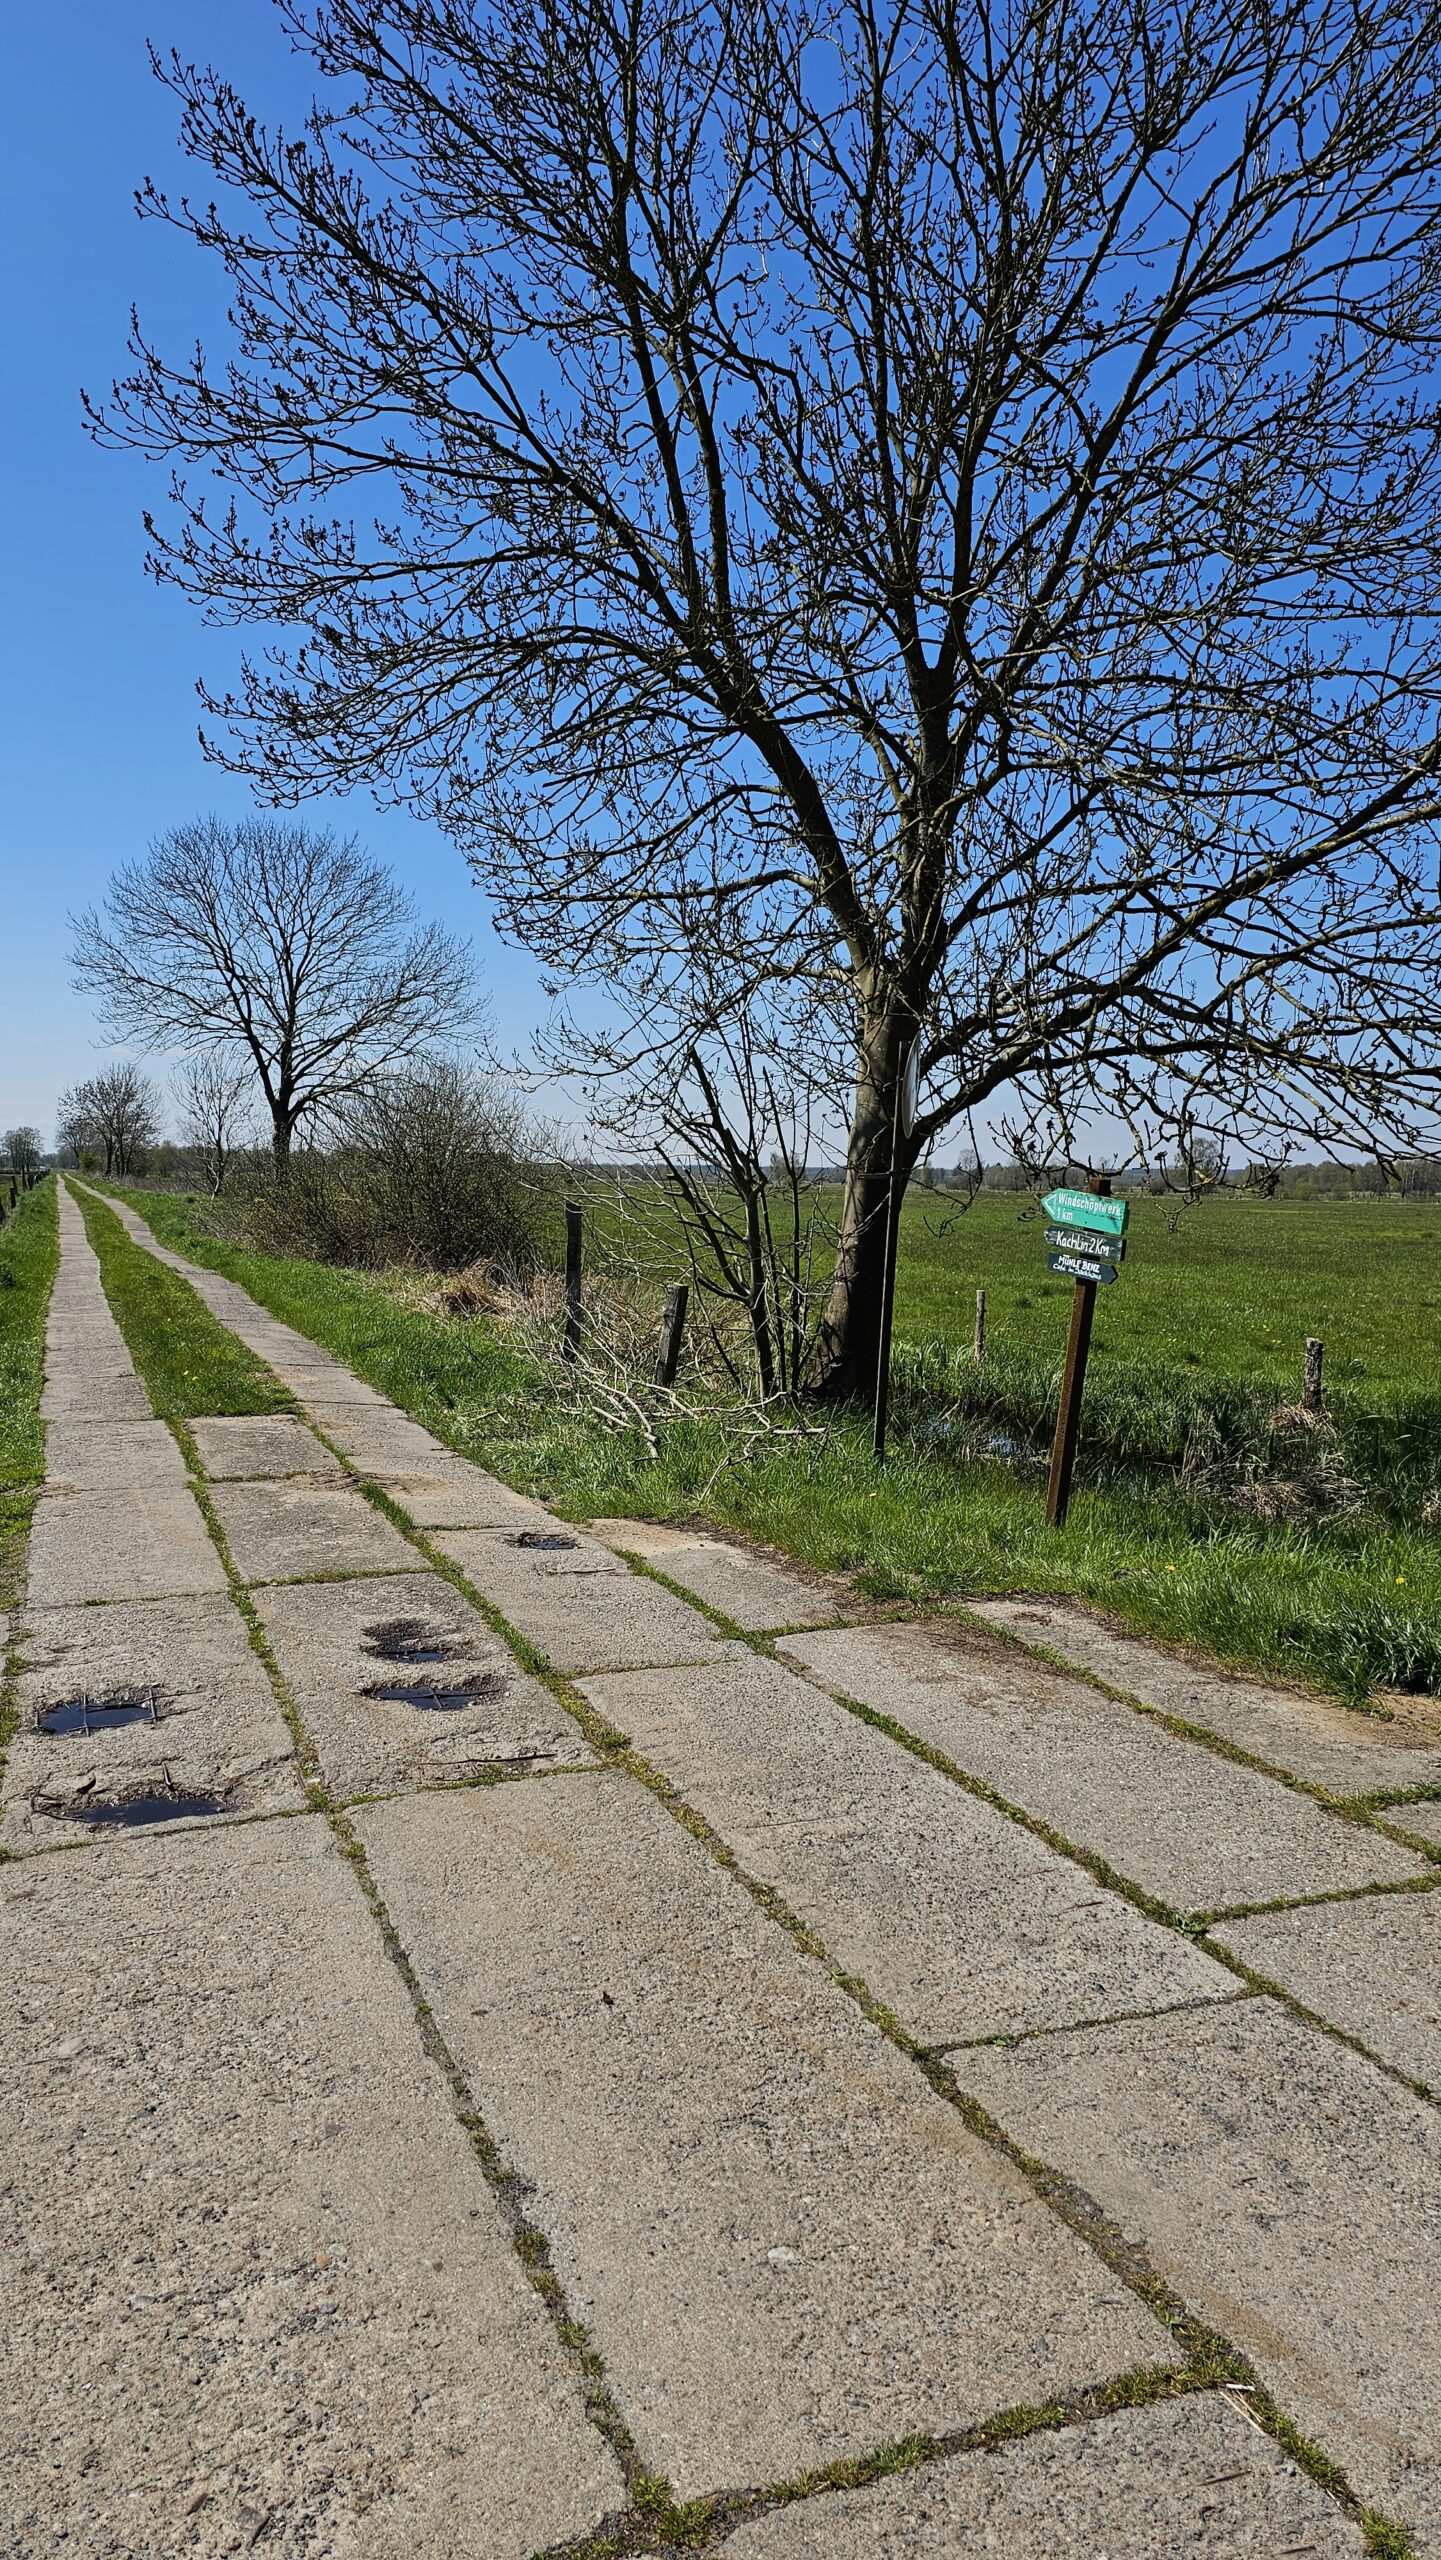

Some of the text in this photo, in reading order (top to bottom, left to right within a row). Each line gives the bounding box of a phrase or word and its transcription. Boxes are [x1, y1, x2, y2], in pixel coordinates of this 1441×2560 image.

[1057, 1207, 1073, 1221] 1 km
[1081, 1260, 1100, 1273] BENZ
